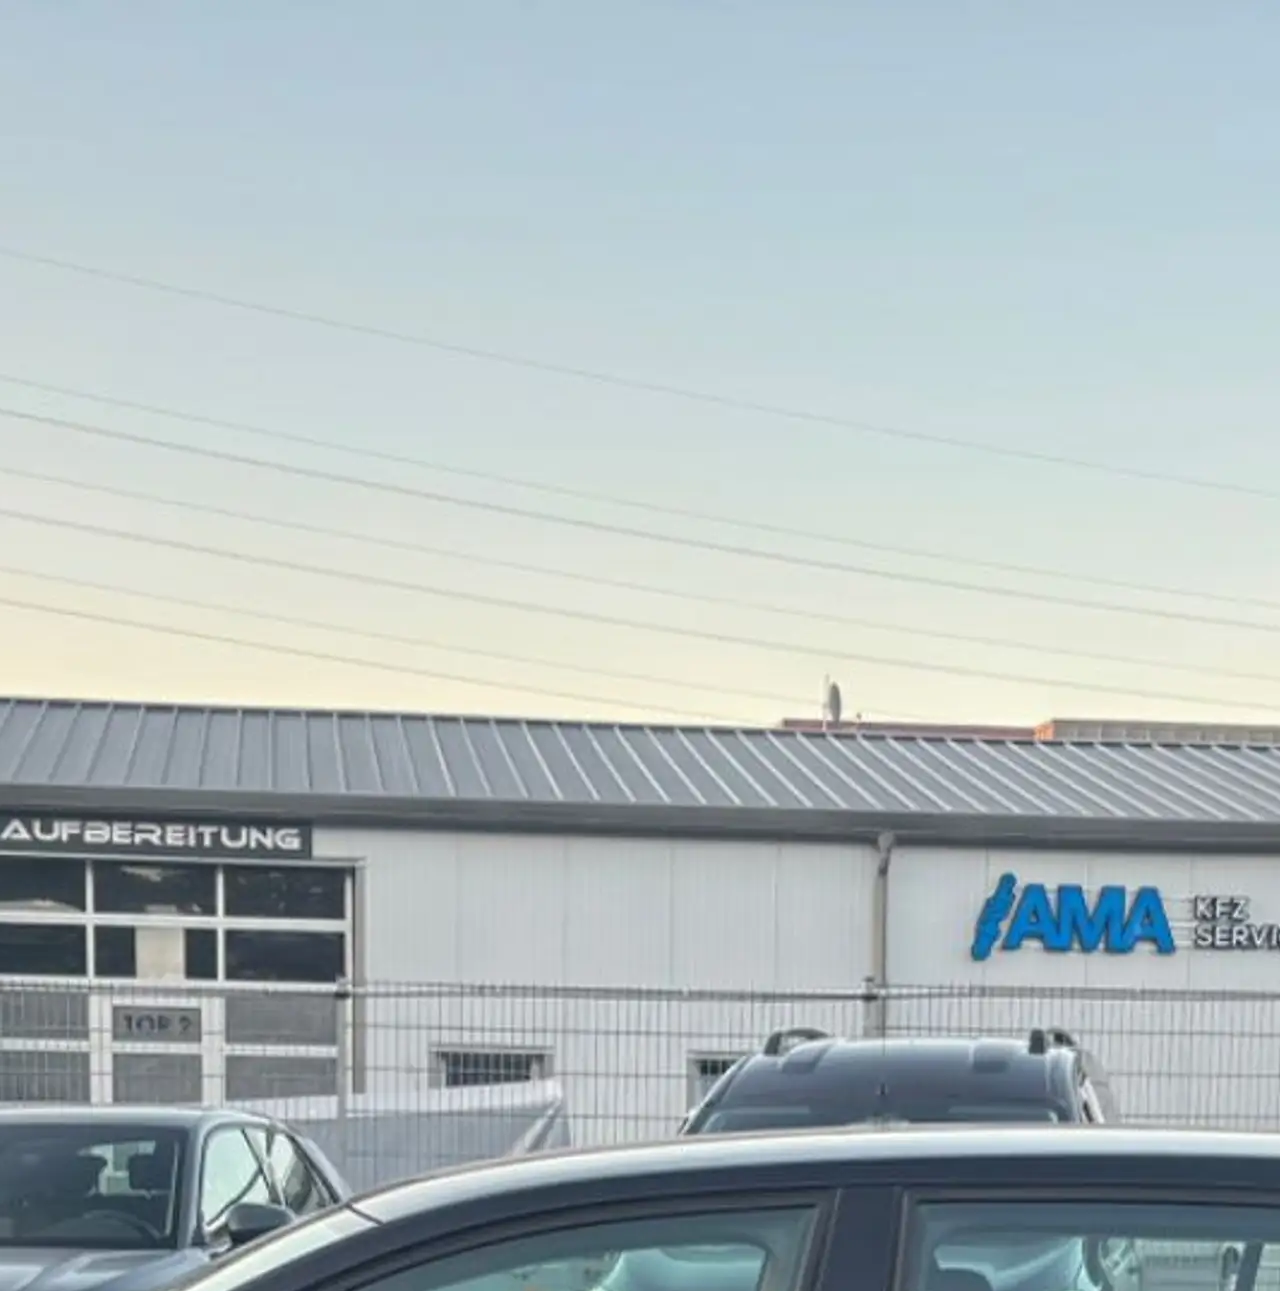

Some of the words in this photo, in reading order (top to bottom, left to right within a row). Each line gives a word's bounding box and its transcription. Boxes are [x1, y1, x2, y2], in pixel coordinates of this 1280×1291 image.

[0, 818, 303, 851] AUFBEREITUNG
[1002, 883, 1176, 955] AMA
[1194, 895, 1250, 921] KFZ
